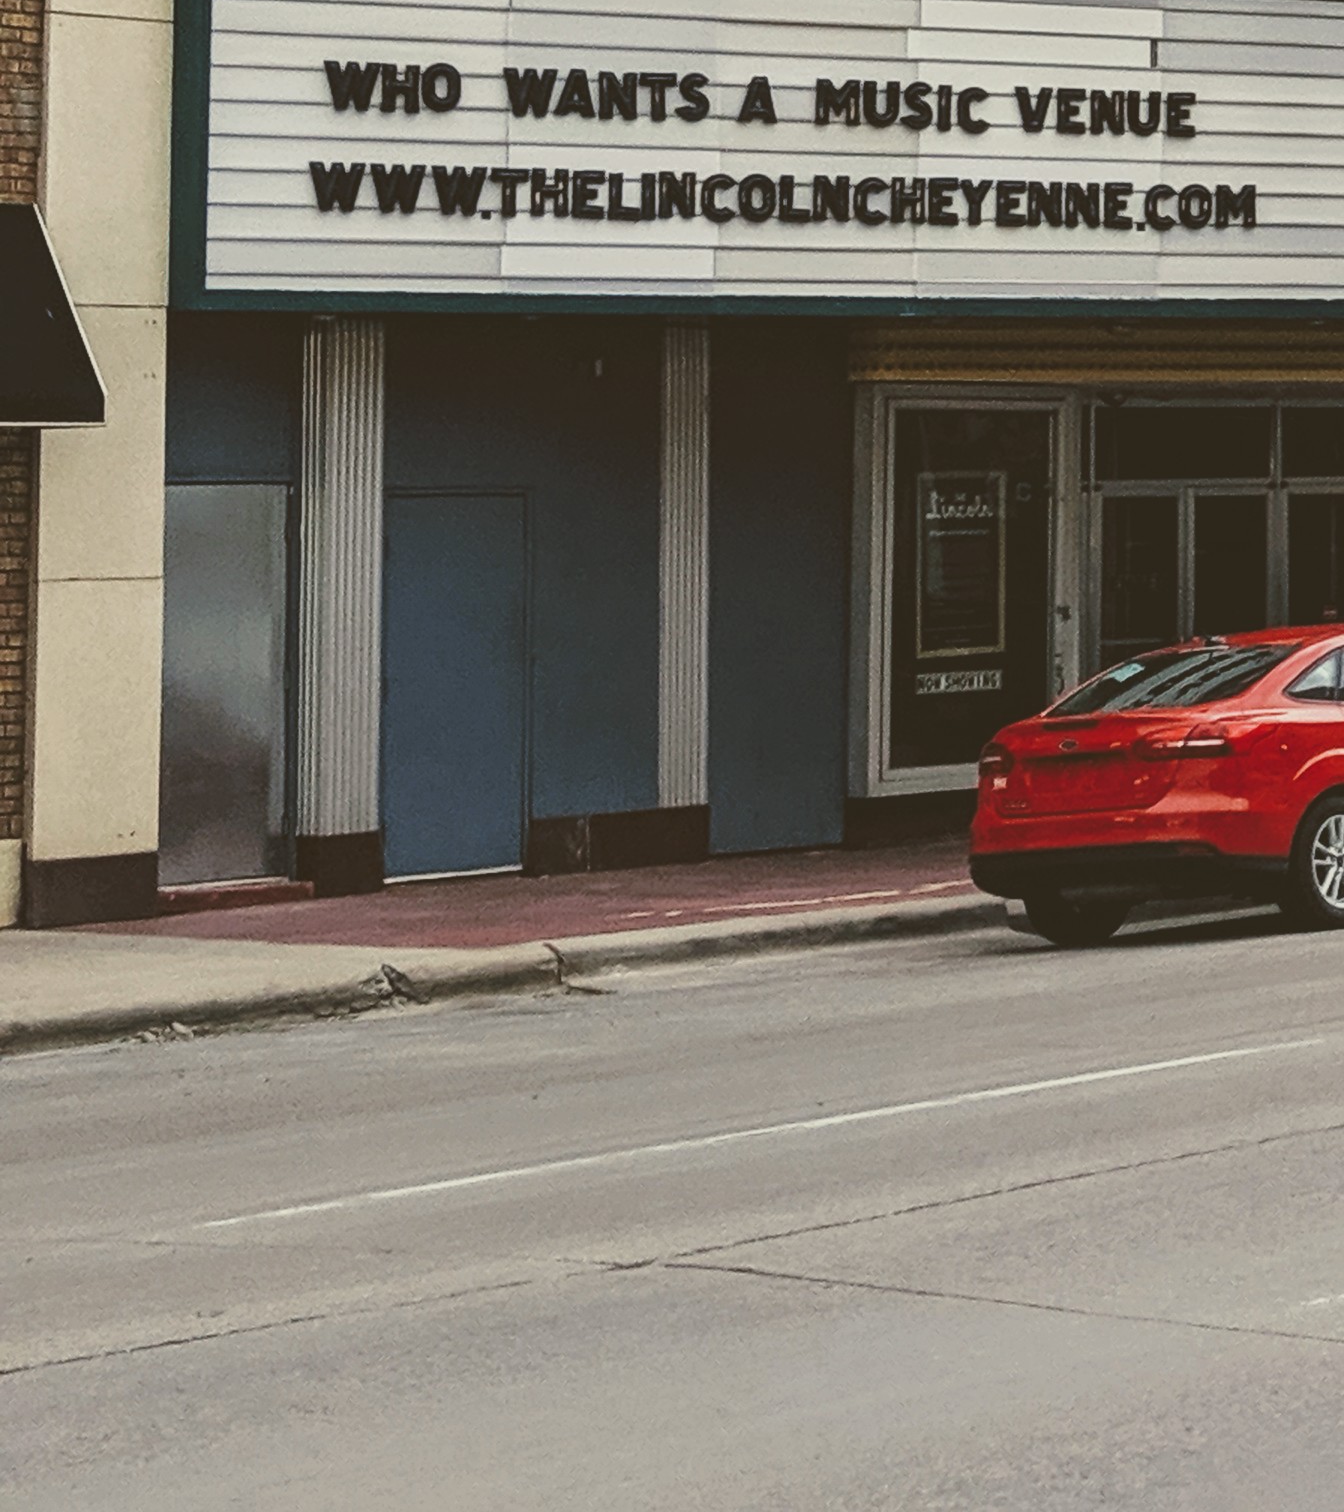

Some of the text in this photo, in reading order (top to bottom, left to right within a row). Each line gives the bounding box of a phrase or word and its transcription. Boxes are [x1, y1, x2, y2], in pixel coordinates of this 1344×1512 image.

[323, 60, 1197, 138] WHO WANTS A MUSIC VENUE
[308, 161, 1258, 232] WWW.THELINCOLNCHEYENNE.COM
